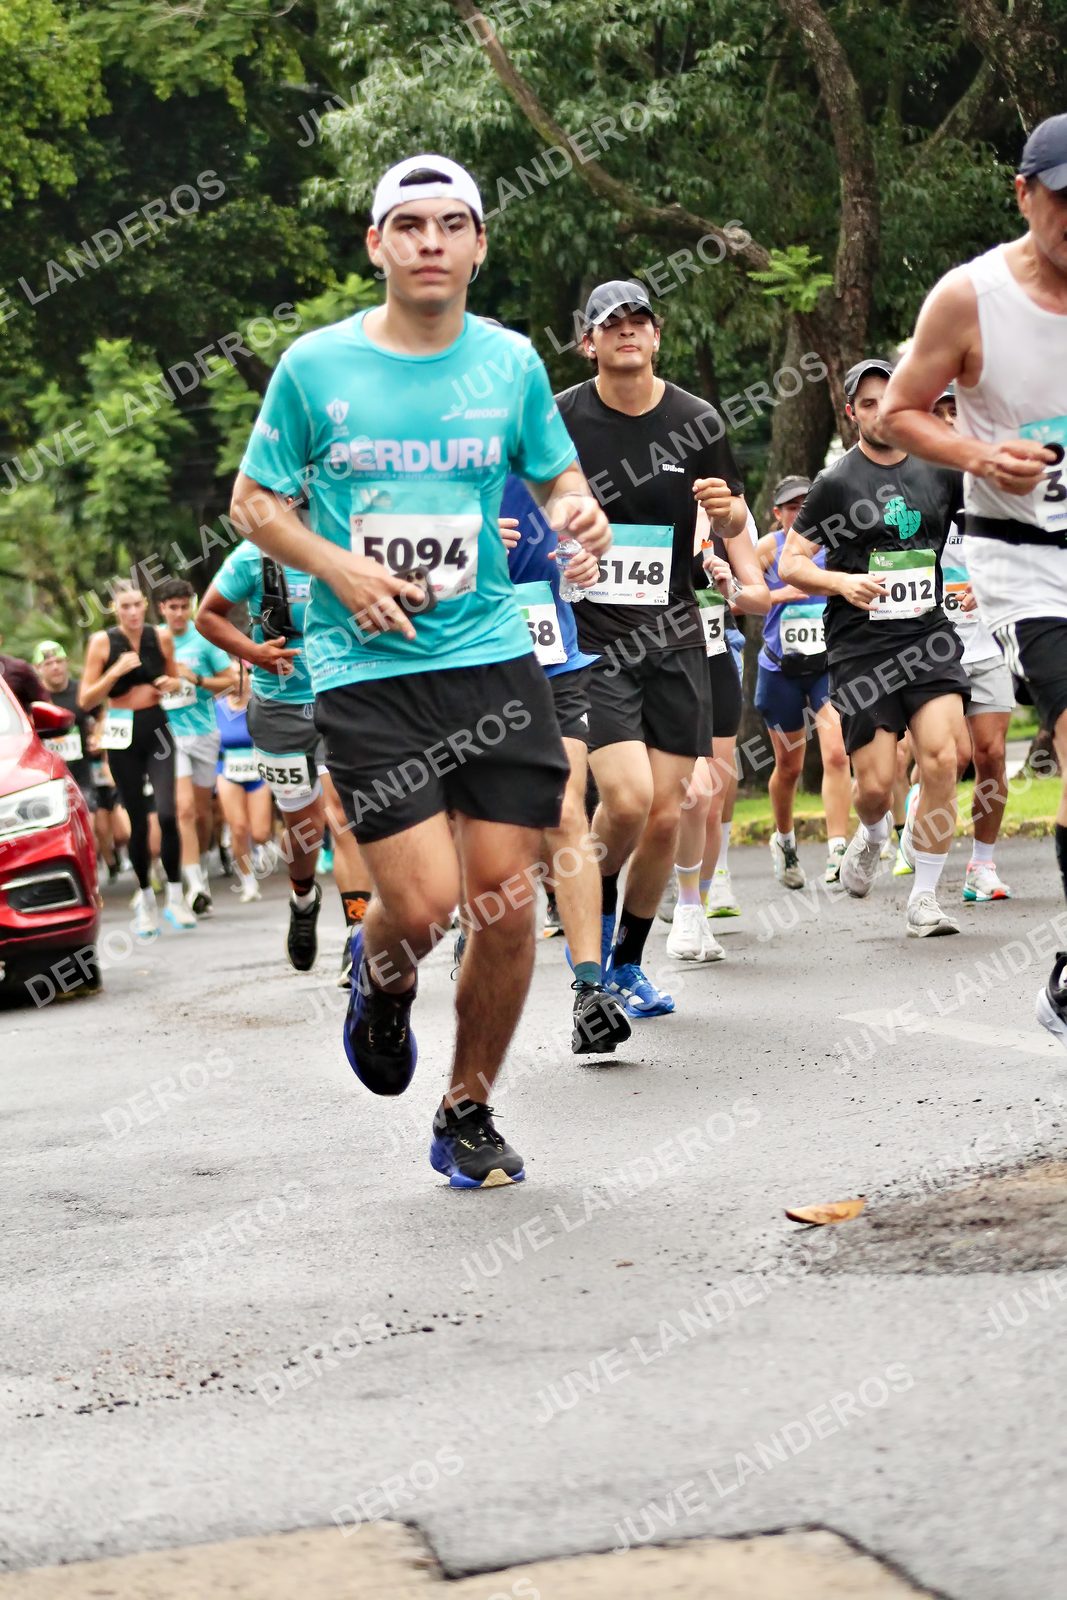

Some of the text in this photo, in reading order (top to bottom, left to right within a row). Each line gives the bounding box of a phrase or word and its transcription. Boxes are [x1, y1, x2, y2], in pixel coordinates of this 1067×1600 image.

[330, 436, 501, 473] PERDURA
[364, 536, 468, 572] 5094
[257, 763, 304, 785] 6535
